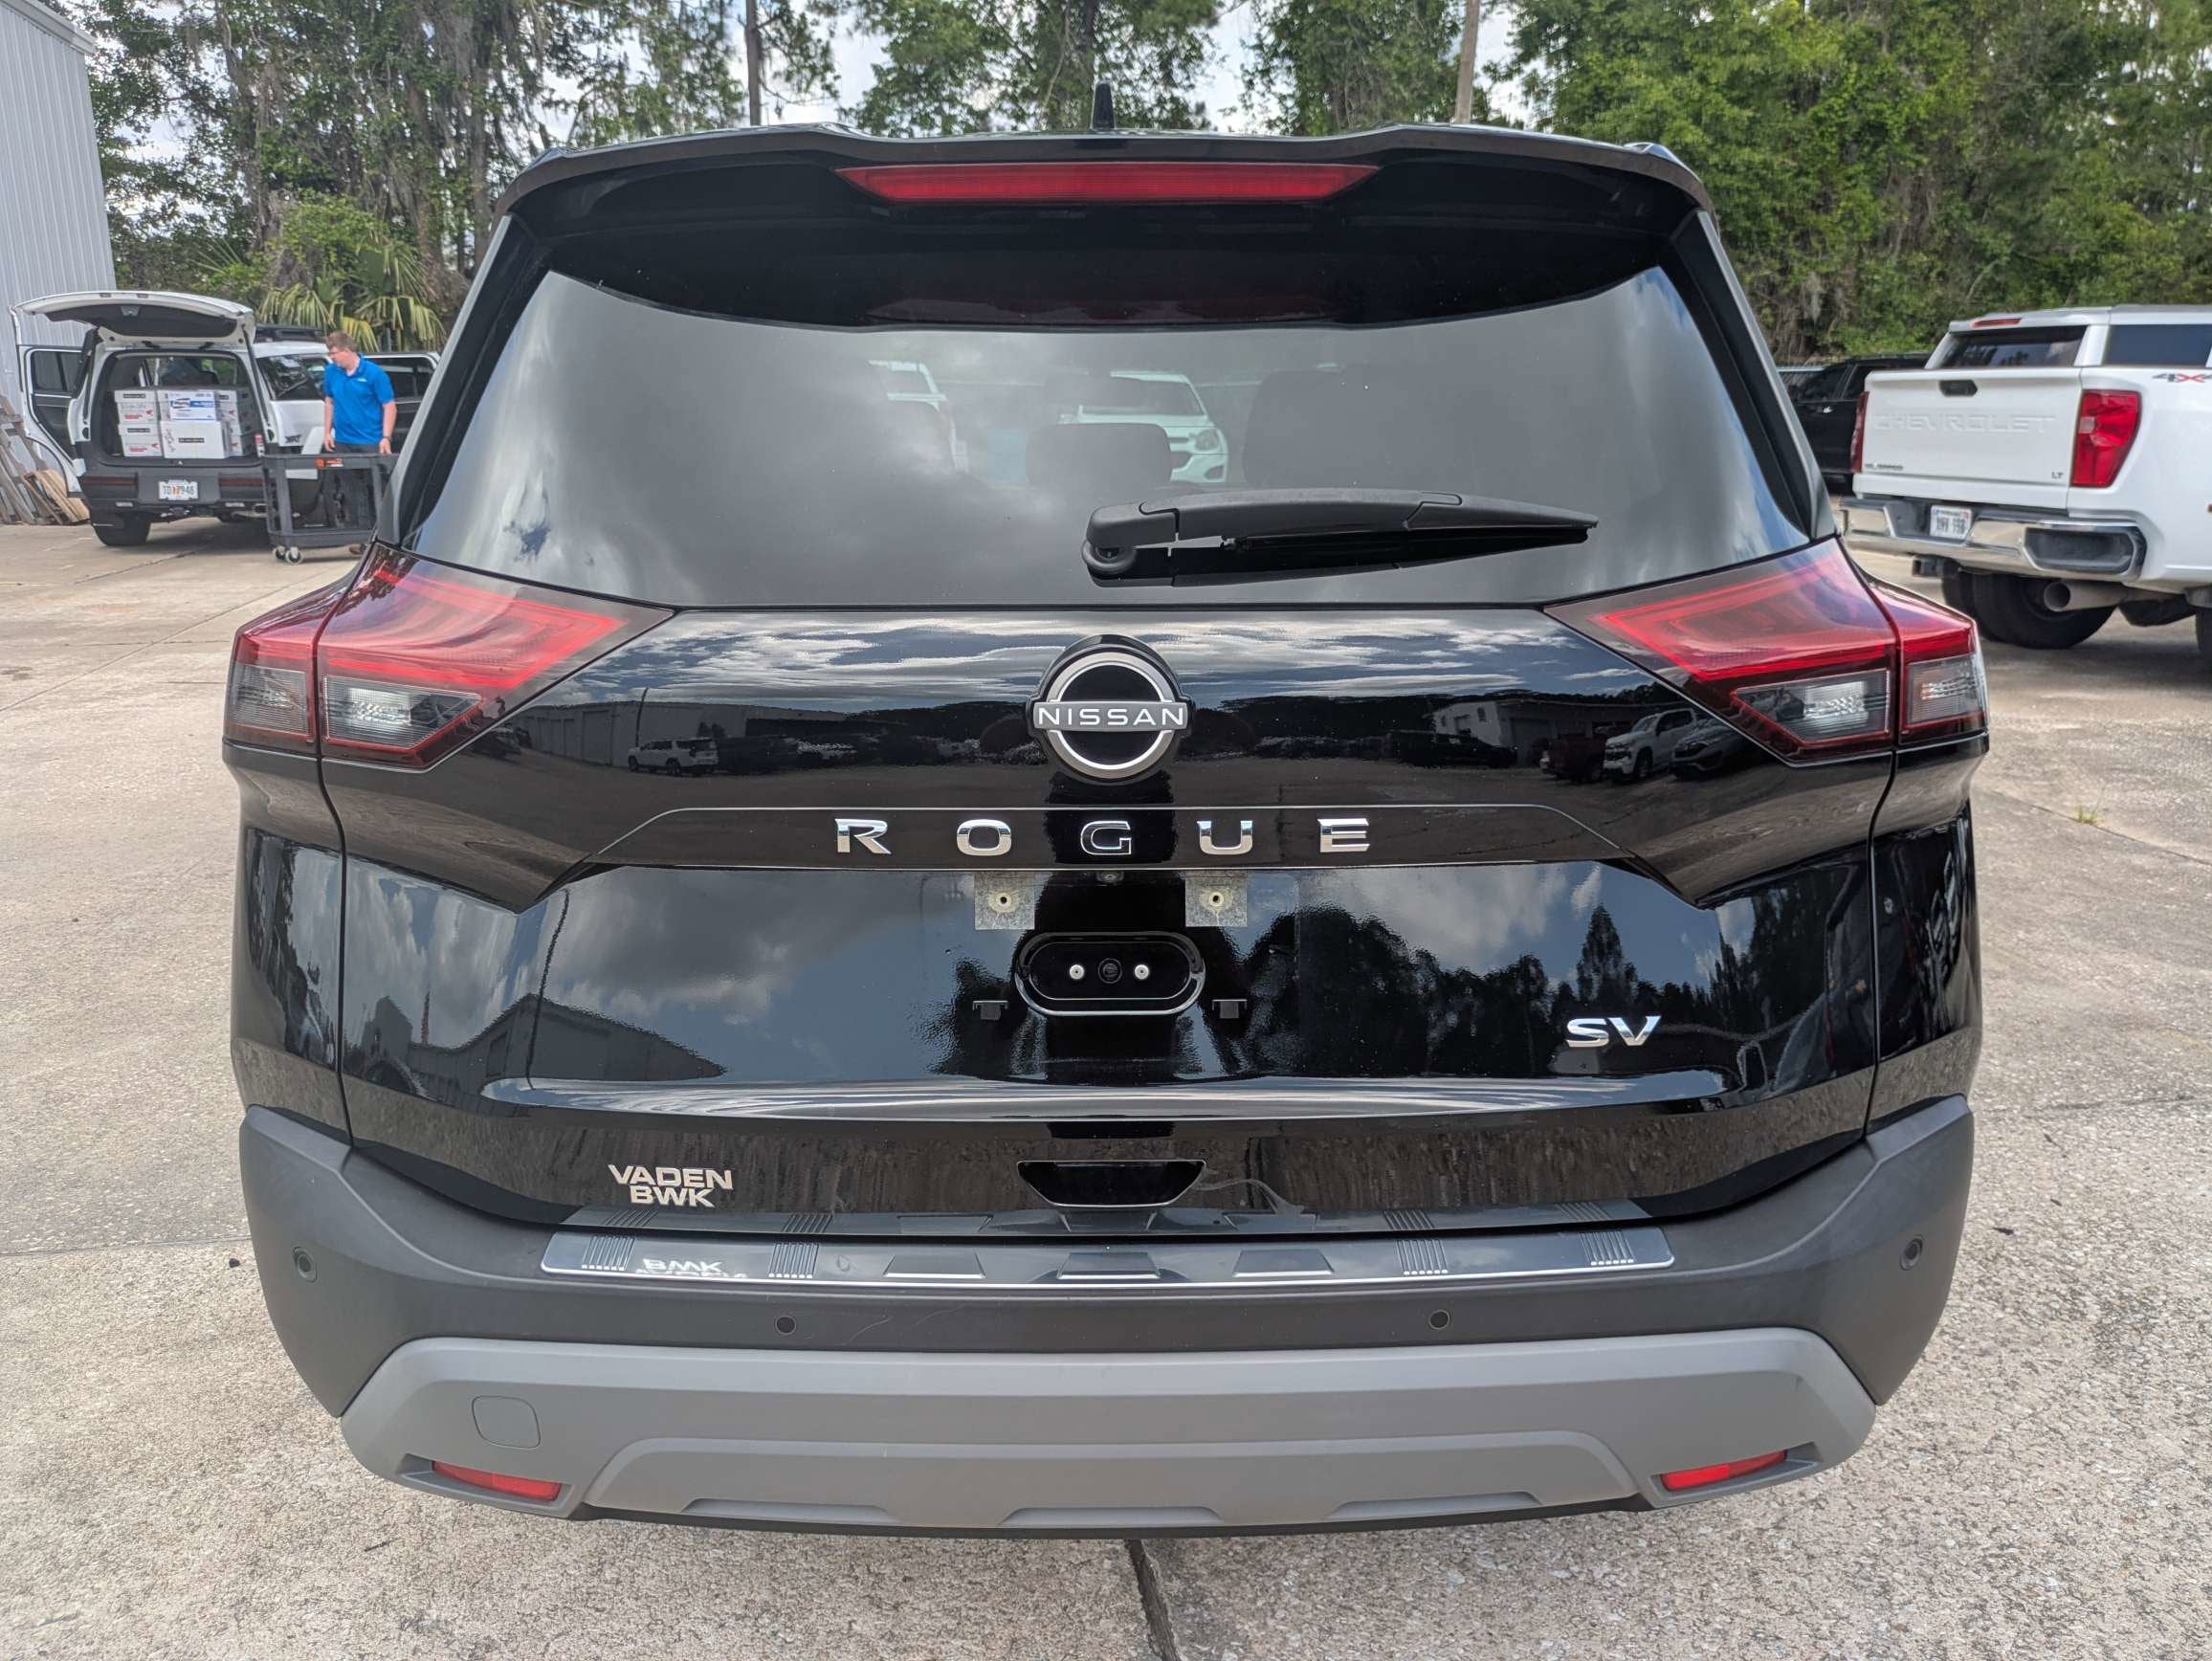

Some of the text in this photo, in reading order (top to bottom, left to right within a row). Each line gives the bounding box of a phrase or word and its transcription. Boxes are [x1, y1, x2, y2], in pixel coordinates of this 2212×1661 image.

[1873, 414, 2057, 433] CHEVROLET
[1038, 708, 1183, 725] NISSAN
[834, 818, 1370, 856] ROGUE
[1565, 1015, 1662, 1048] SV
[608, 1164, 734, 1190] VADEN
[630, 1185, 716, 1207] BWK
